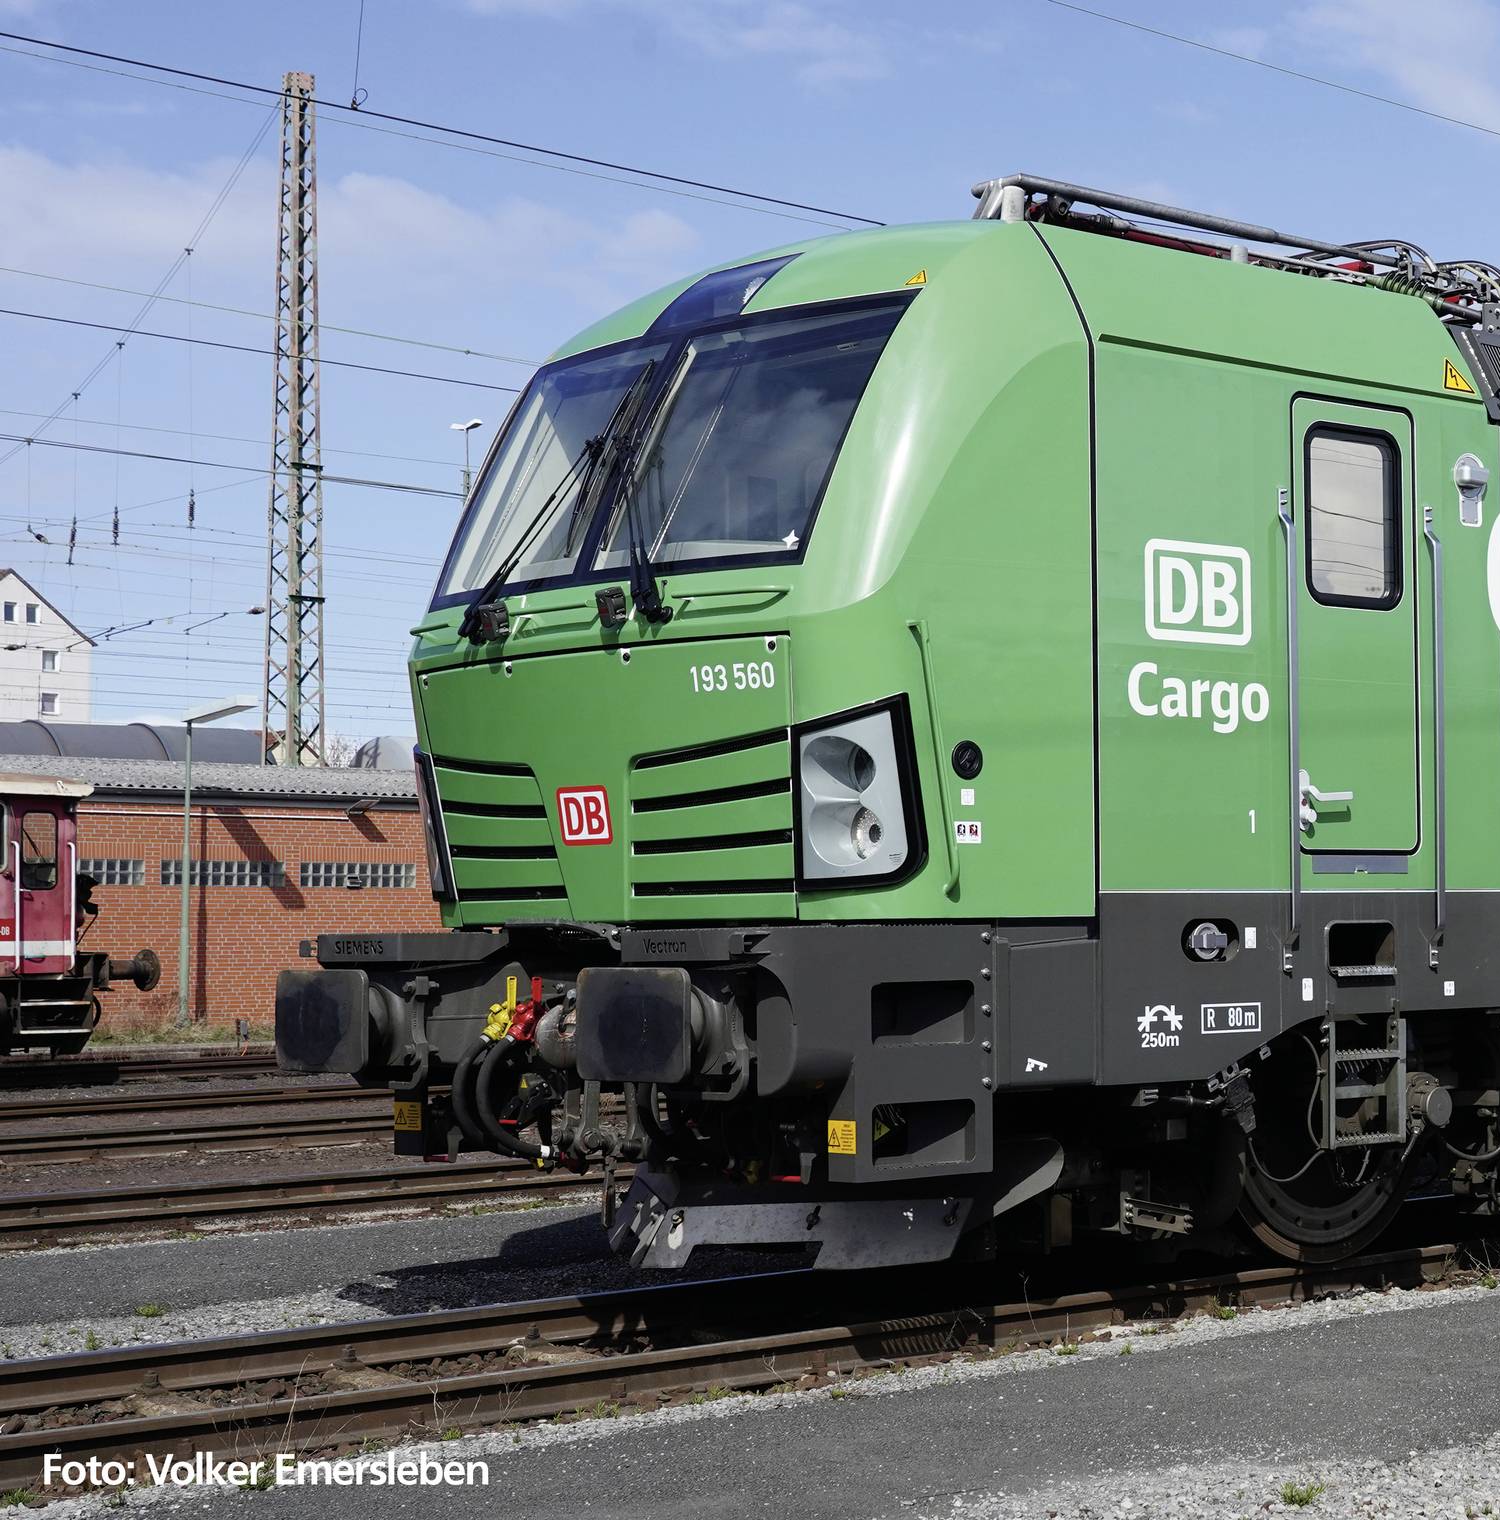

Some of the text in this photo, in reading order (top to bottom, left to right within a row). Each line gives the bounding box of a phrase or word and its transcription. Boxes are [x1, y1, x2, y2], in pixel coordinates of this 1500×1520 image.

[1157, 553, 1242, 630] DB
[690, 661, 775, 692] 193 560
[1127, 661, 1270, 734] Cargo
[562, 794, 606, 838] DB
[1248, 809, 1256, 834] 1
[335, 940, 384, 955] SIEMENS
[642, 938, 688, 954] Vectron
[1207, 1008, 1216, 1028] R
[1141, 1032, 1180, 1048] 250m
